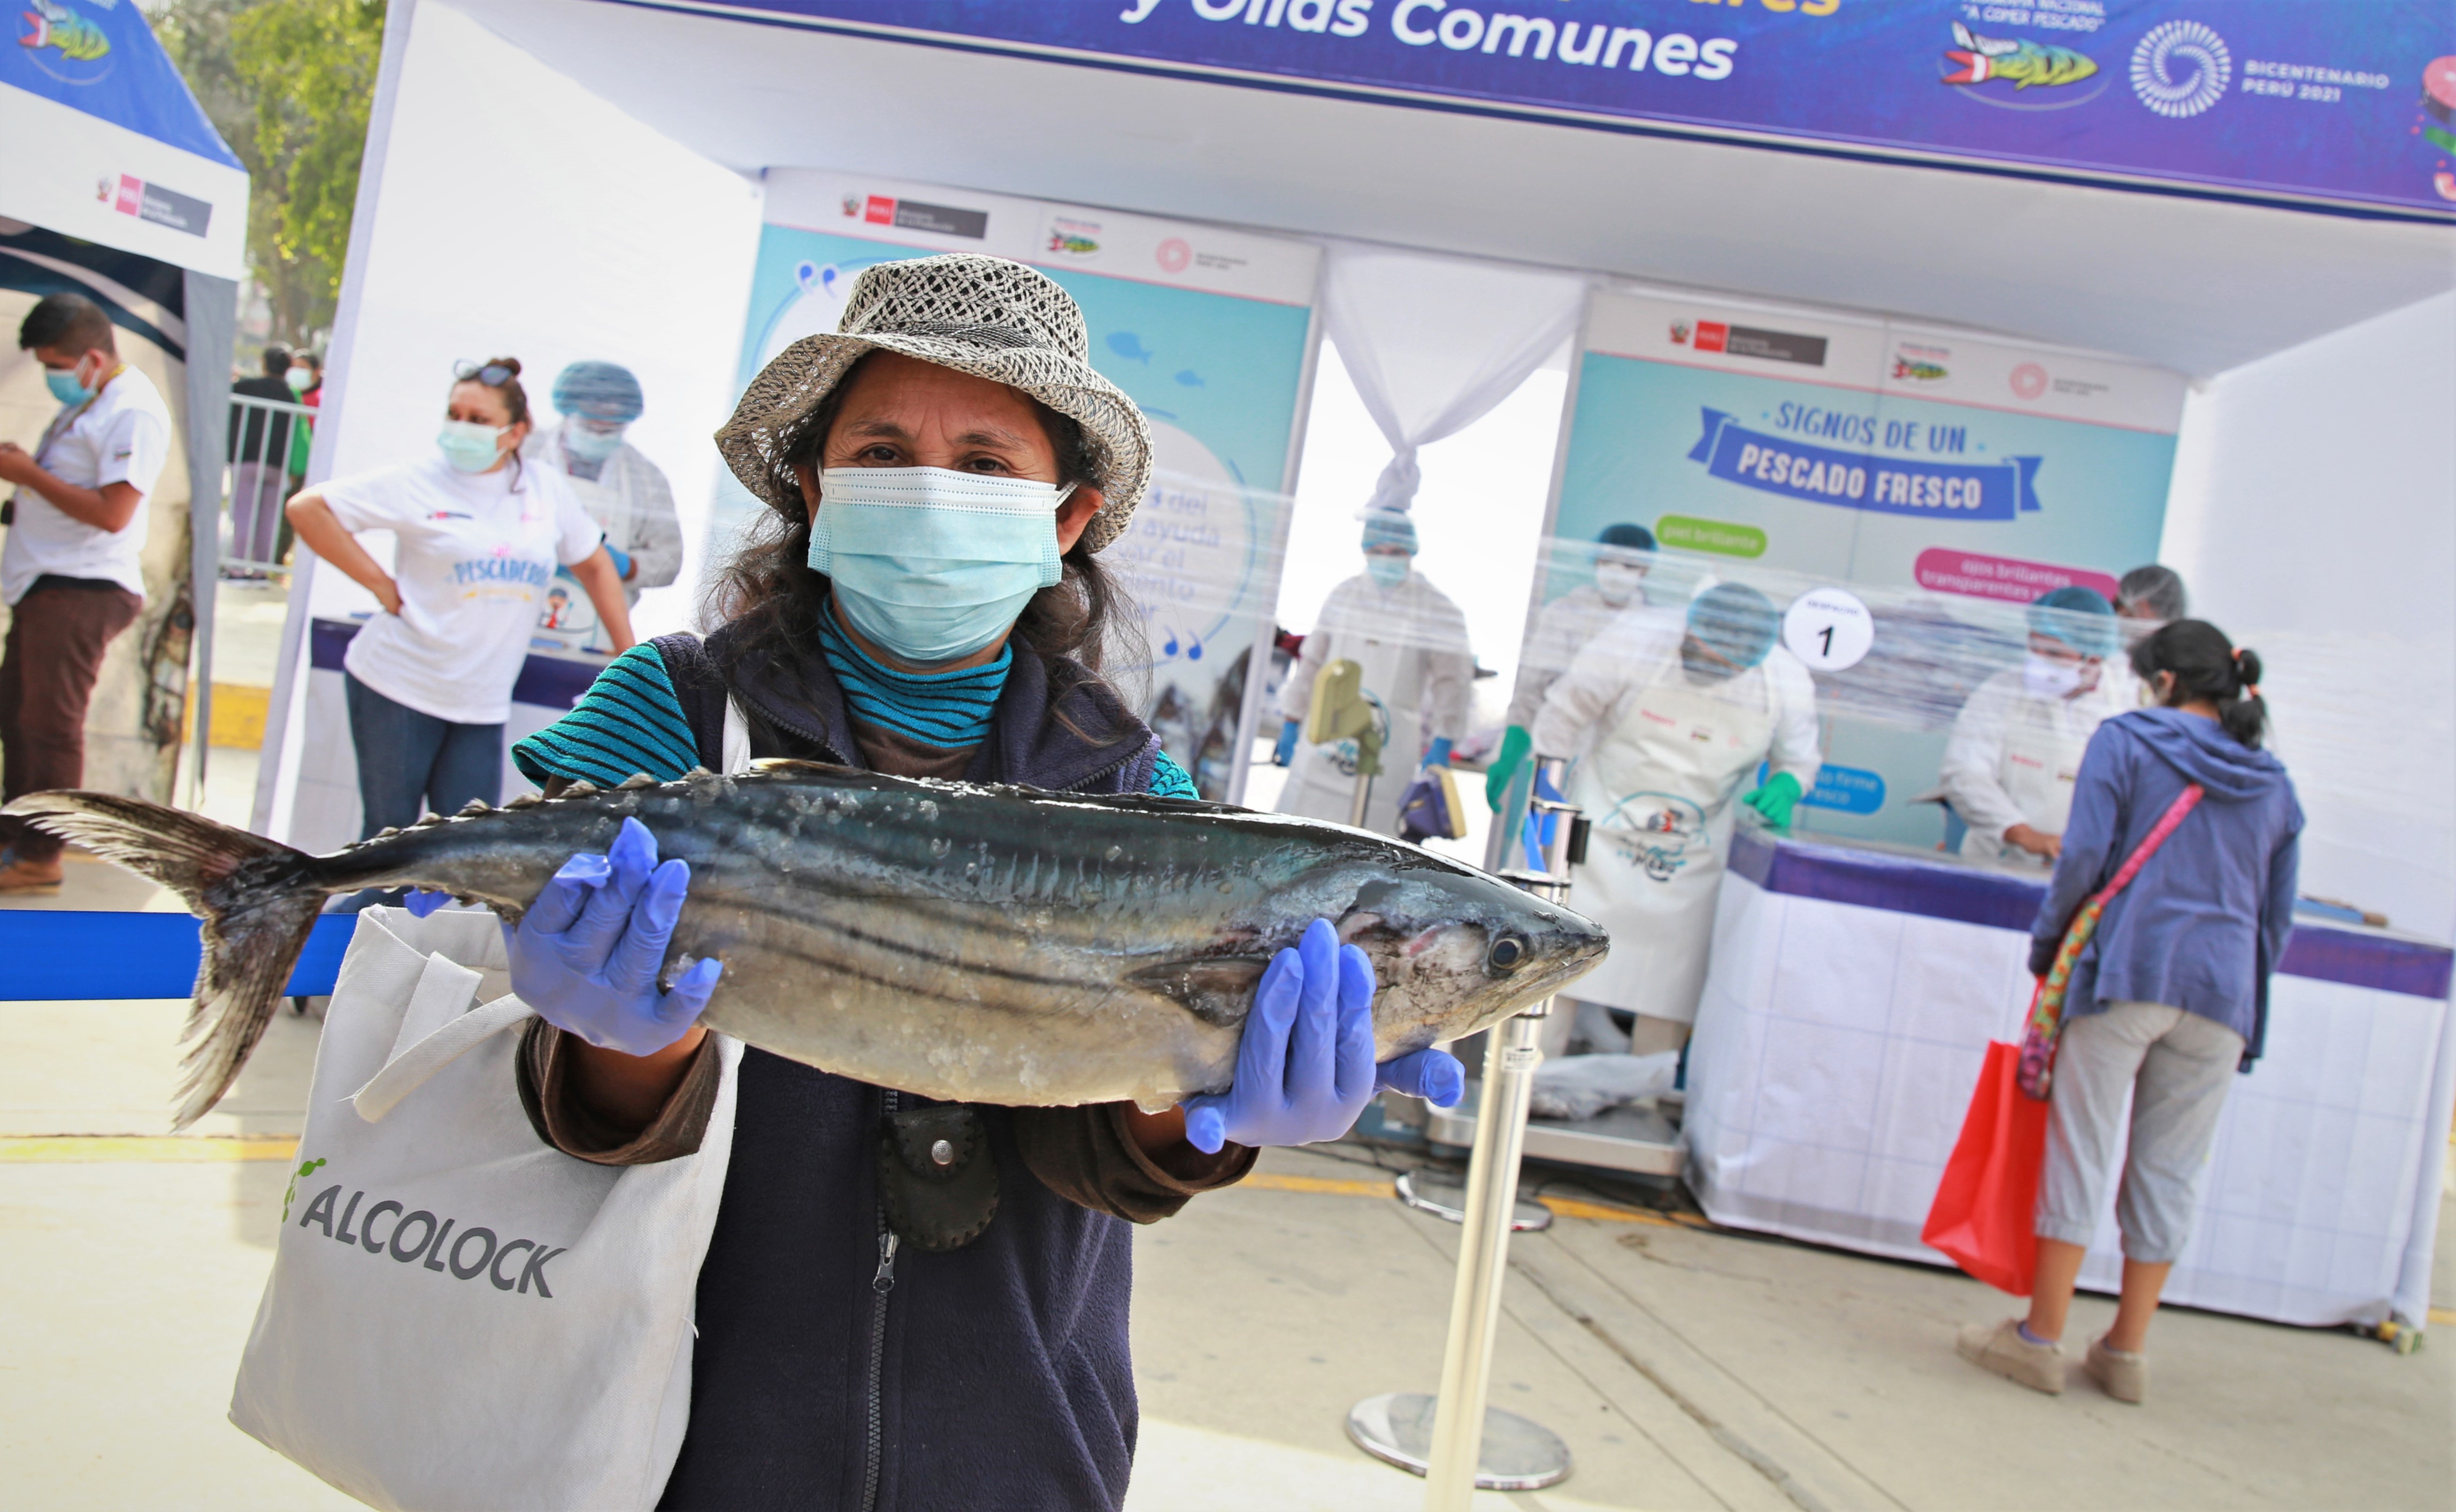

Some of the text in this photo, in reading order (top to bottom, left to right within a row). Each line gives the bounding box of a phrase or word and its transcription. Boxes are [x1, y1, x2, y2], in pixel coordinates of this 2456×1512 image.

[1391, 0, 1738, 80] Comunes
[2241, 76, 2342, 103] PERÚ 2021
[2244, 59, 2390, 90] BICENTENARIO
[1775, 401, 1967, 453] SIGNOS DE UN
[1737, 443, 1982, 510] PESCADO FRESCO
[1960, 558, 2071, 587] ojos brillantes
[1818, 625, 1833, 657] 1
[300, 1184, 567, 1298] ALCOLOCK
